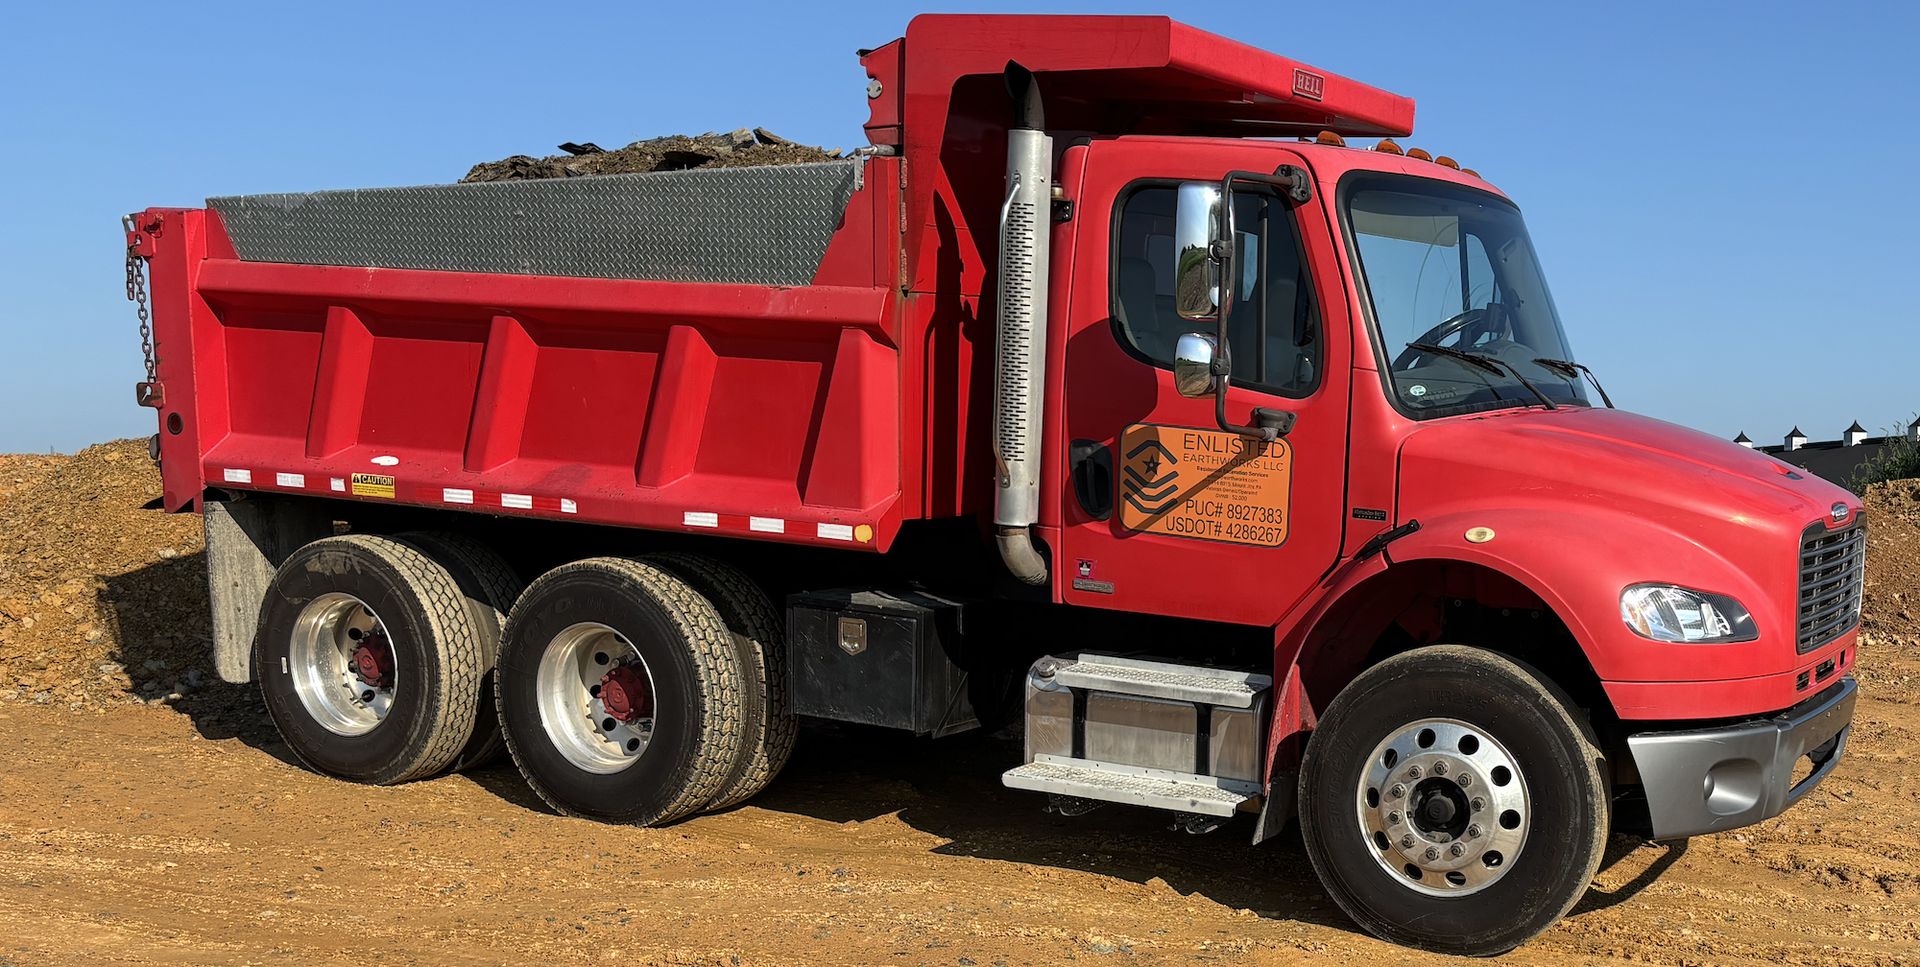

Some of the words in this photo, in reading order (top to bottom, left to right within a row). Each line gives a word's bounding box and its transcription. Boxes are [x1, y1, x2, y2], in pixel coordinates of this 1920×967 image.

[1297, 73, 1320, 95] HEIL
[1183, 433, 1285, 459] ENLISTED
[1183, 453, 1260, 470] EARTHWORKS
[1263, 461, 1284, 472] LLC
[361, 475, 392, 485] CAUTION
[1186, 499, 1223, 519] PUC#
[1226, 504, 1283, 525] 8927383
[1166, 516, 1222, 537] USDOT#
[1226, 523, 1282, 543] 4286267
